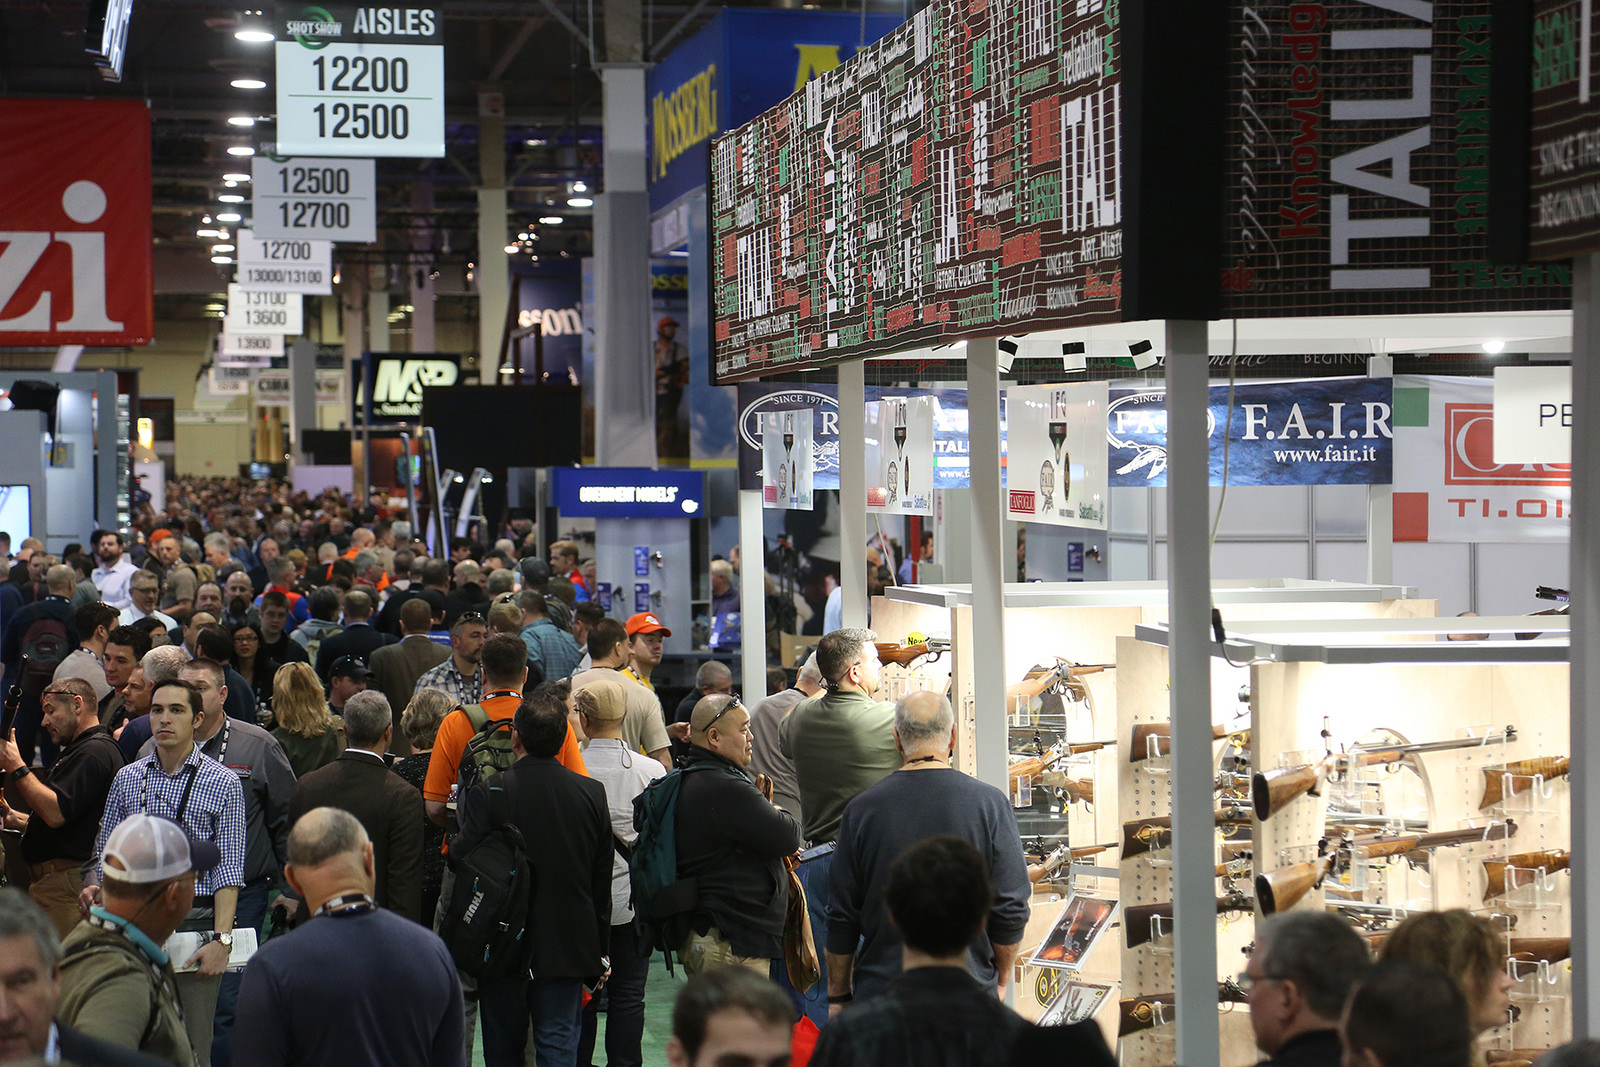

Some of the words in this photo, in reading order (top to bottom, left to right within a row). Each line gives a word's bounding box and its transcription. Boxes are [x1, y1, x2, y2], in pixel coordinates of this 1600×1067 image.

[353, 8, 436, 36] AISLES
[1063, 25, 1103, 87] reliability
[313, 56, 409, 92] 12200
[313, 103, 409, 140] 12500
[1456, 16, 1492, 236] EXPERIENCE
[964, 24, 975, 253] QUALITY
[1330, 0, 1433, 290] ITALI
[973, 103, 981, 211] KNOW
[279, 167, 350, 194] 12500
[1030, 172, 1061, 224] DESIGN
[279, 202, 350, 228] 12700
[262, 241, 310, 260] 12700
[248, 269, 322, 283] 13000/13100
[737, 224, 772, 322] ITALIA
[958, 261, 987, 287] CULTURE
[246, 310, 286, 325] 13600
[774, 395, 804, 405] SINCE
[1133, 394, 1163, 405] SINCE
[1273, 444, 1377, 462] www.fair.it
[463, 891, 485, 924] THULE
